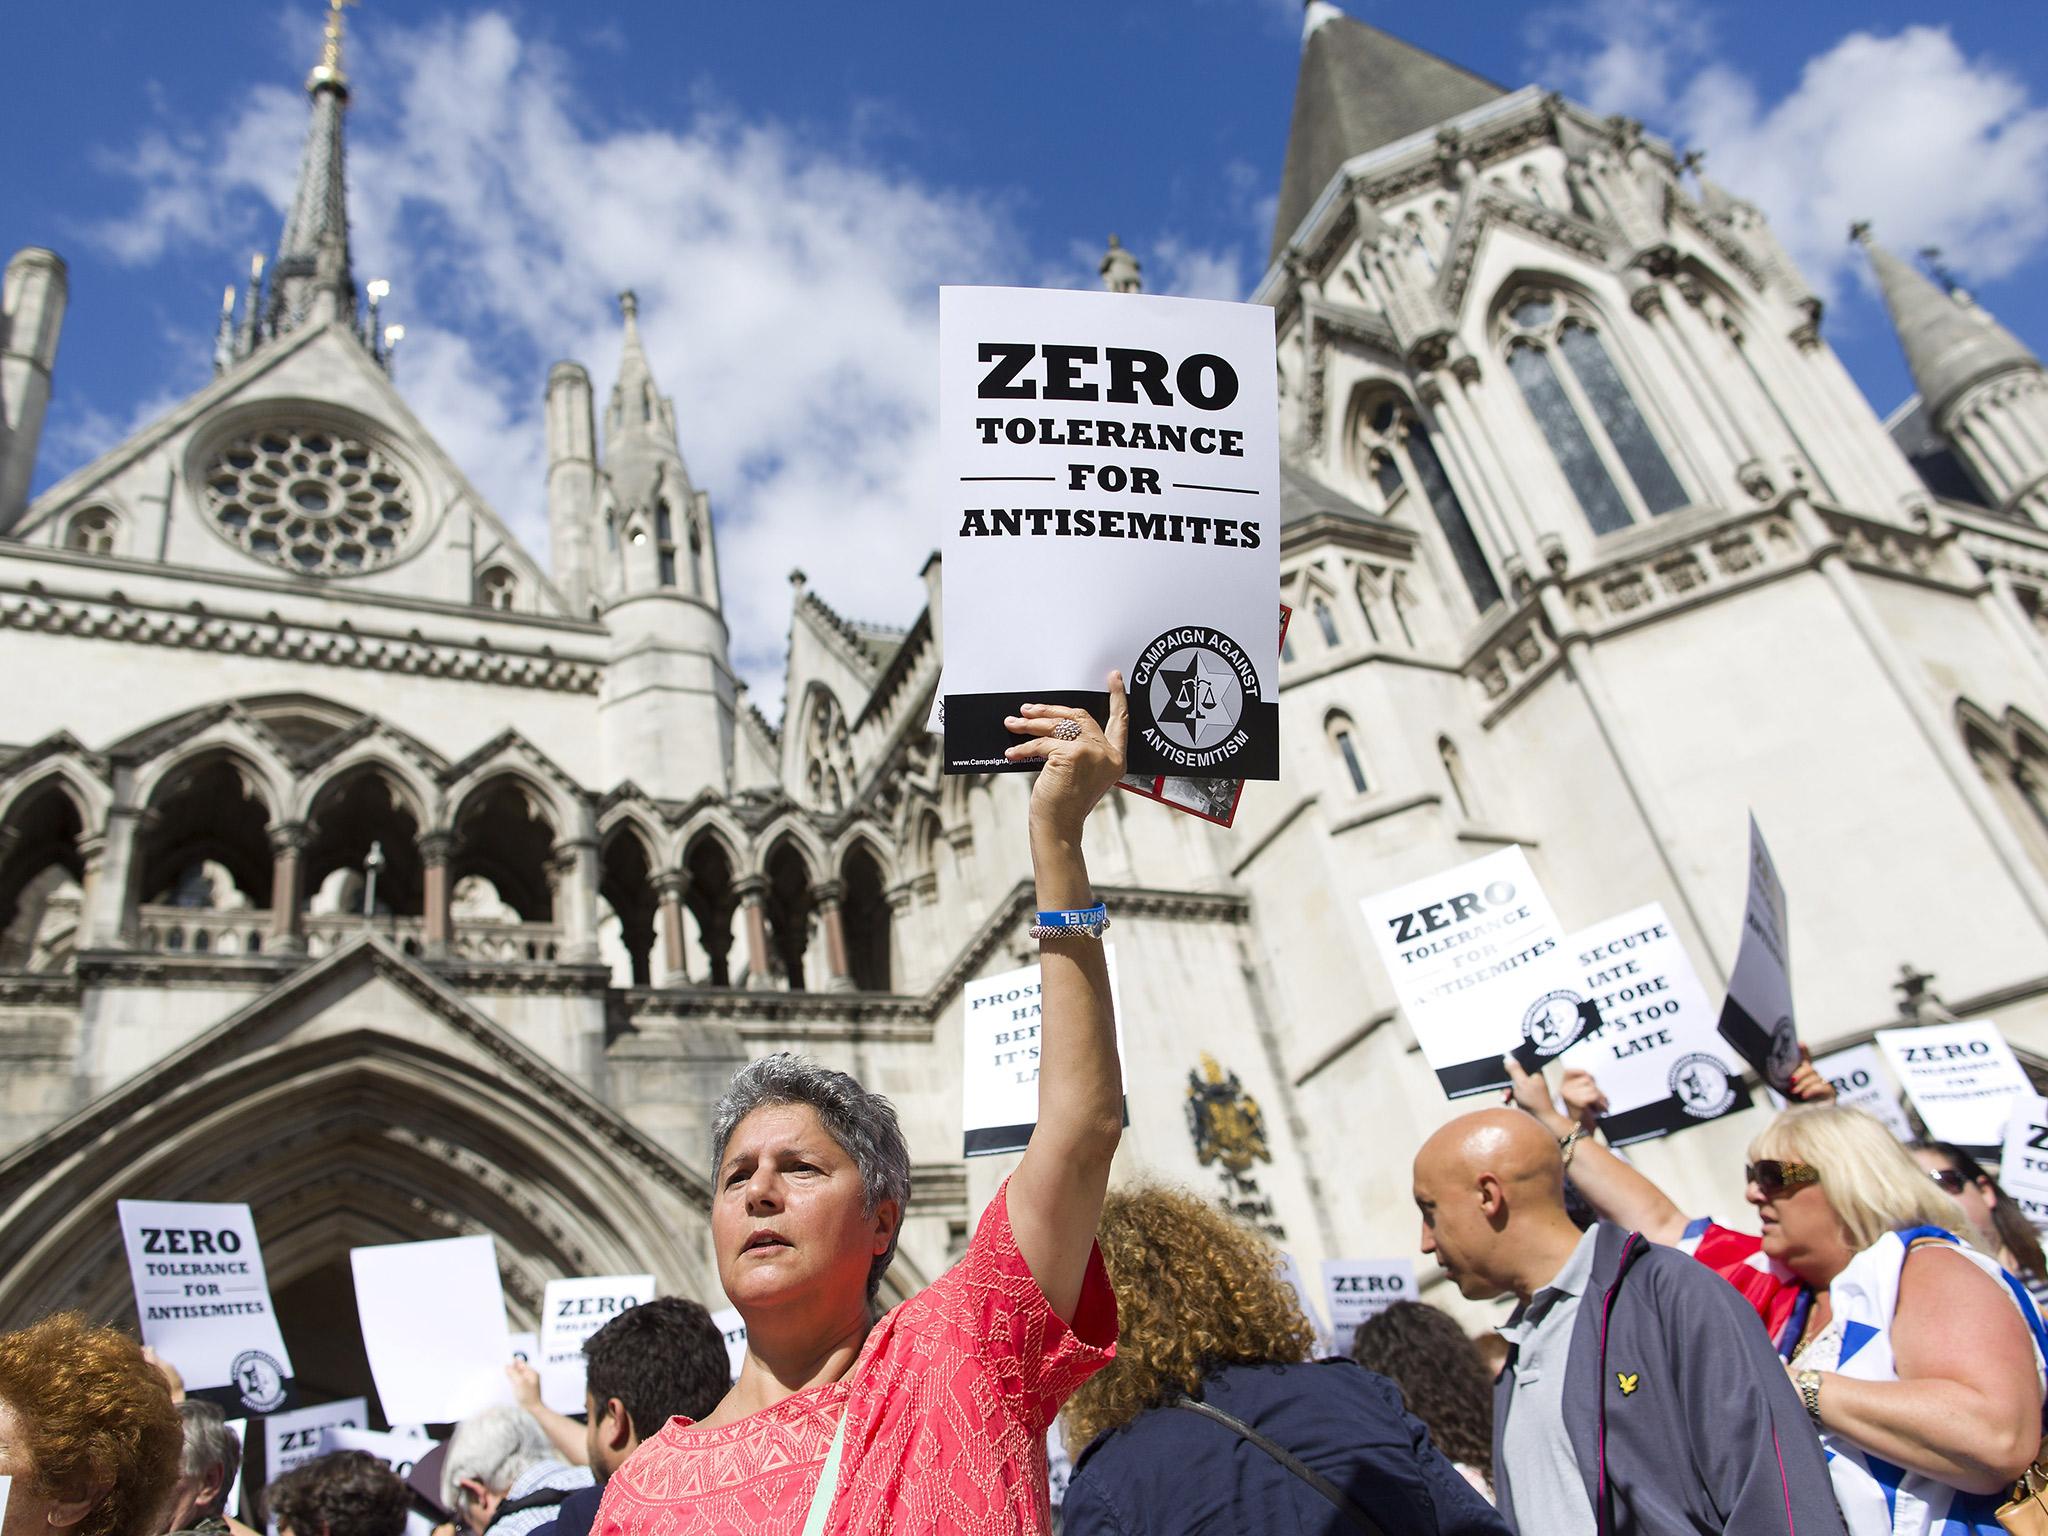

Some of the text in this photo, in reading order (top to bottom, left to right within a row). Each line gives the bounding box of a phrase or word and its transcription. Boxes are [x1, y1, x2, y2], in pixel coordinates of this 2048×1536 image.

[977, 342, 1239, 411] ZERO
[975, 417, 1244, 457] TOLERANCE
[1067, 463, 1162, 495] FOR
[959, 509, 1261, 549] ANTISEMITES
[1135, 629, 1259, 697] CAMPAIGN AGAINST
[1141, 727, 1250, 767] ANTISEMITISM
[1388, 880, 1516, 944] ZERO
[1401, 905, 1531, 964] TOLERANCE
[1579, 924, 1668, 967] SECUTE
[1452, 943, 1499, 968] FOR
[1630, 999, 1680, 1026] TOO
[1612, 1029, 1673, 1060] LATE
[1903, 1040, 1990, 1063] ZERO
[1829, 1069, 1870, 1095] RO
[140, 1228, 241, 1255] ZERO
[145, 1261, 249, 1276] TOLERANCE
[183, 1283, 220, 1297] FOR
[1332, 1275, 1404, 1292] ZERO
[147, 1302, 264, 1320] ANTISEMITES
[558, 1295, 638, 1317] ZERO
